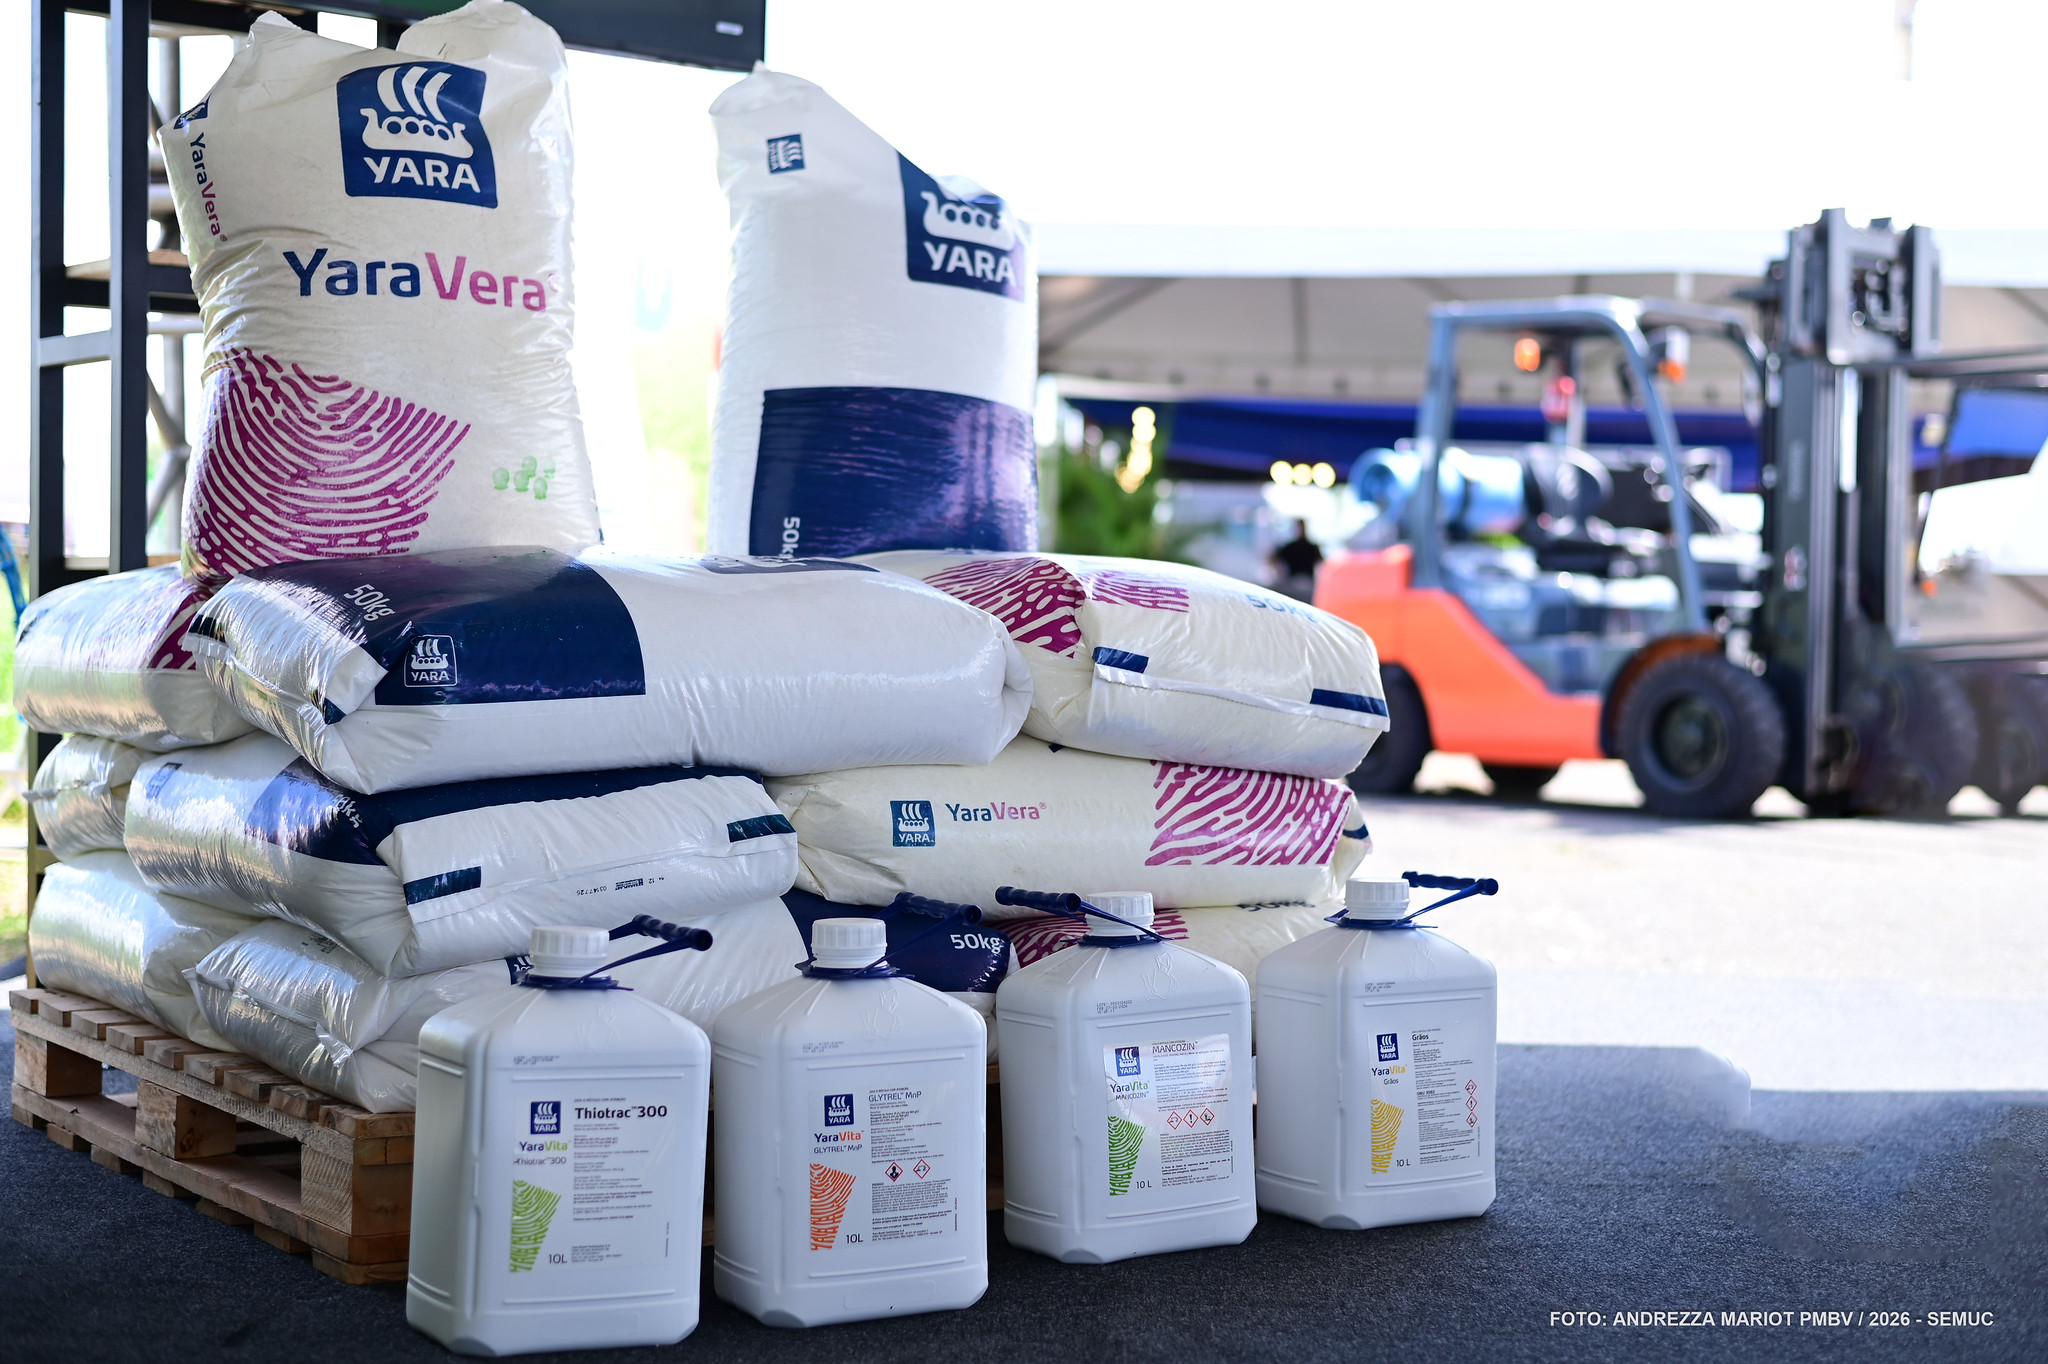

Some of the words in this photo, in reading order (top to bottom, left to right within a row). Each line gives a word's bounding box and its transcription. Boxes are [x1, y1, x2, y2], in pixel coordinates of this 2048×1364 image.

[363, 156, 481, 194] YARA
[923, 241, 1017, 288] YARA
[343, 583, 396, 622] 50kg
[411, 670, 450, 682] YARA
[898, 833, 931, 843] YARA
[950, 933, 1001, 955] 50kg
[1380, 1052, 1397, 1060] YARA
[1119, 1066, 1139, 1075] YARA
[828, 1115, 851, 1125] YARA
[534, 1124, 558, 1133] YARA
